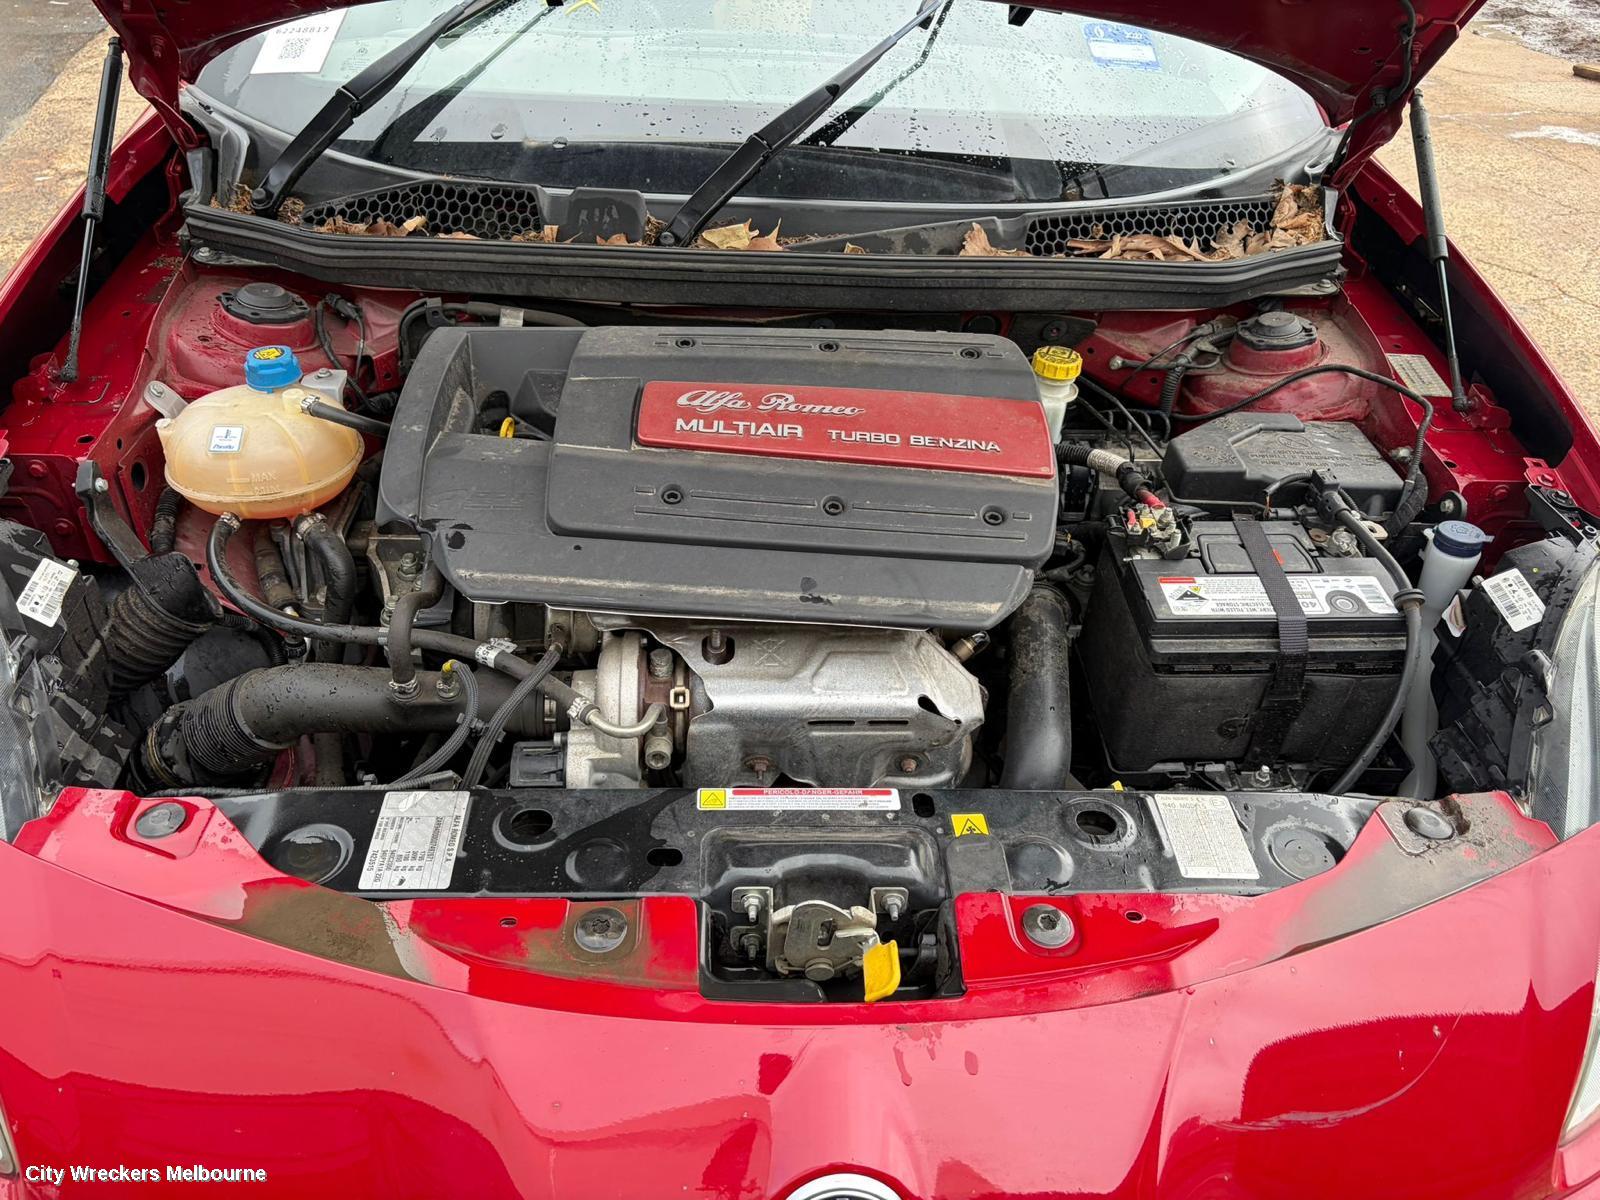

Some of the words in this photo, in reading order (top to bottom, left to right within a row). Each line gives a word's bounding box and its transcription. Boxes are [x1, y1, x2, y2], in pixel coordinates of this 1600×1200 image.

[676, 389, 750, 413] Alfa
[757, 392, 865, 417] Romeo
[676, 418, 803, 438] MULTIAIR
[828, 429, 901, 446] TURBO
[909, 435, 1001, 452] BENZINA
[250, 472, 278, 483] MAX
[447, 828, 458, 846] ROMEO
